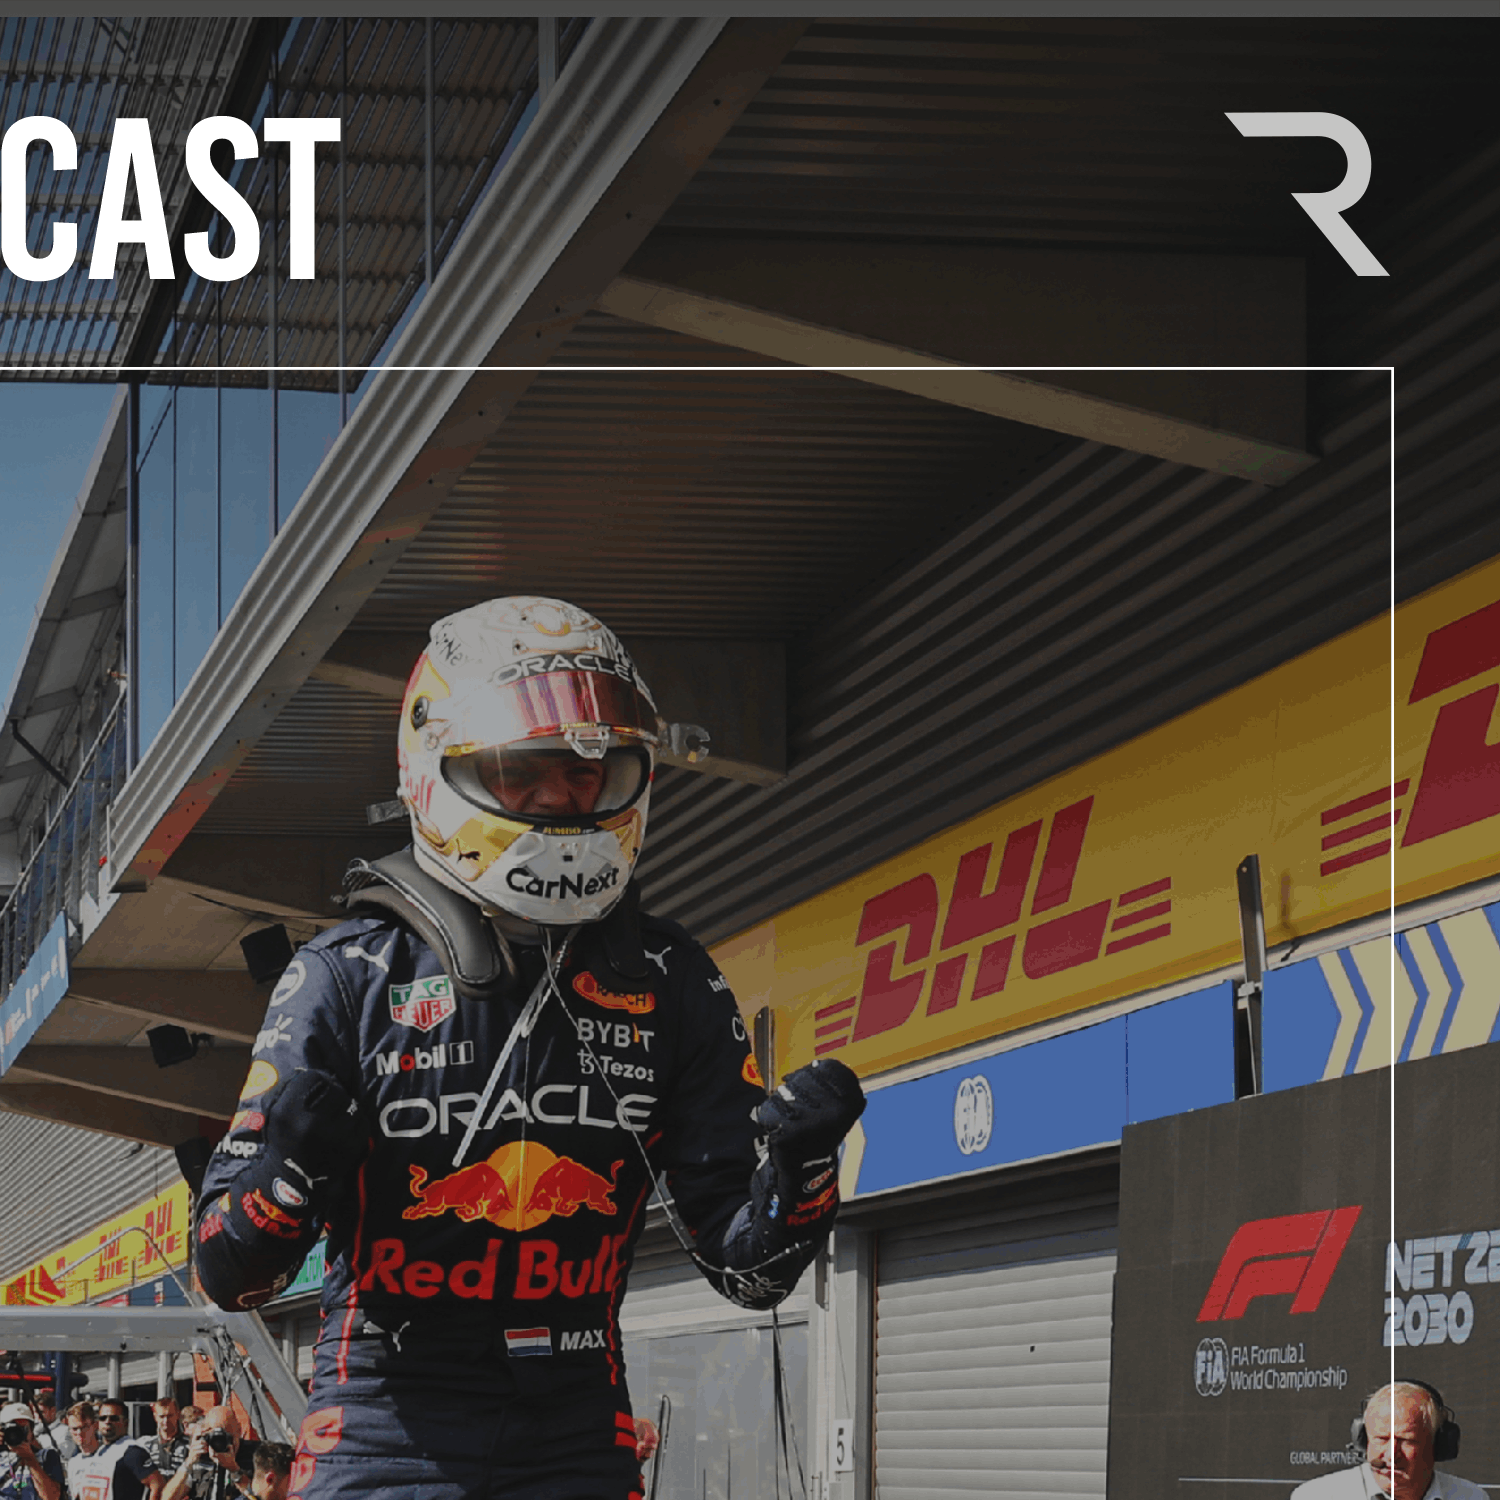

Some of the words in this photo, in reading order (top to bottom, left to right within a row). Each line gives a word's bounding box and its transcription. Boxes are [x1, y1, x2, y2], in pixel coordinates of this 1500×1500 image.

[492, 654, 633, 683] ORACLE
[506, 867, 619, 899] CarNext
[852, 795, 1112, 1043] DHL
[392, 976, 449, 1005] TAG
[392, 998, 453, 1029] HEUER
[577, 1017, 655, 1052] BYBIT
[376, 1046, 447, 1077] Mobil
[600, 1055, 655, 1082] Tezos
[379, 1084, 658, 1138] ORACLE
[359, 1237, 503, 1300] Red
[512, 1235, 625, 1300] Bull
[1384, 1236, 1462, 1292] NET
[1383, 1290, 1475, 1347] 2030
[560, 1329, 607, 1351] MAX
[1230, 1345, 1250, 1367] FIA
[1251, 1343, 1298, 1365] Formula
[1230, 1370, 1263, 1390] World
[1263, 1365, 1348, 1392] Championship
[836, 1427, 845, 1466] 5
[1289, 1451, 1320, 1465] GLOBAL
